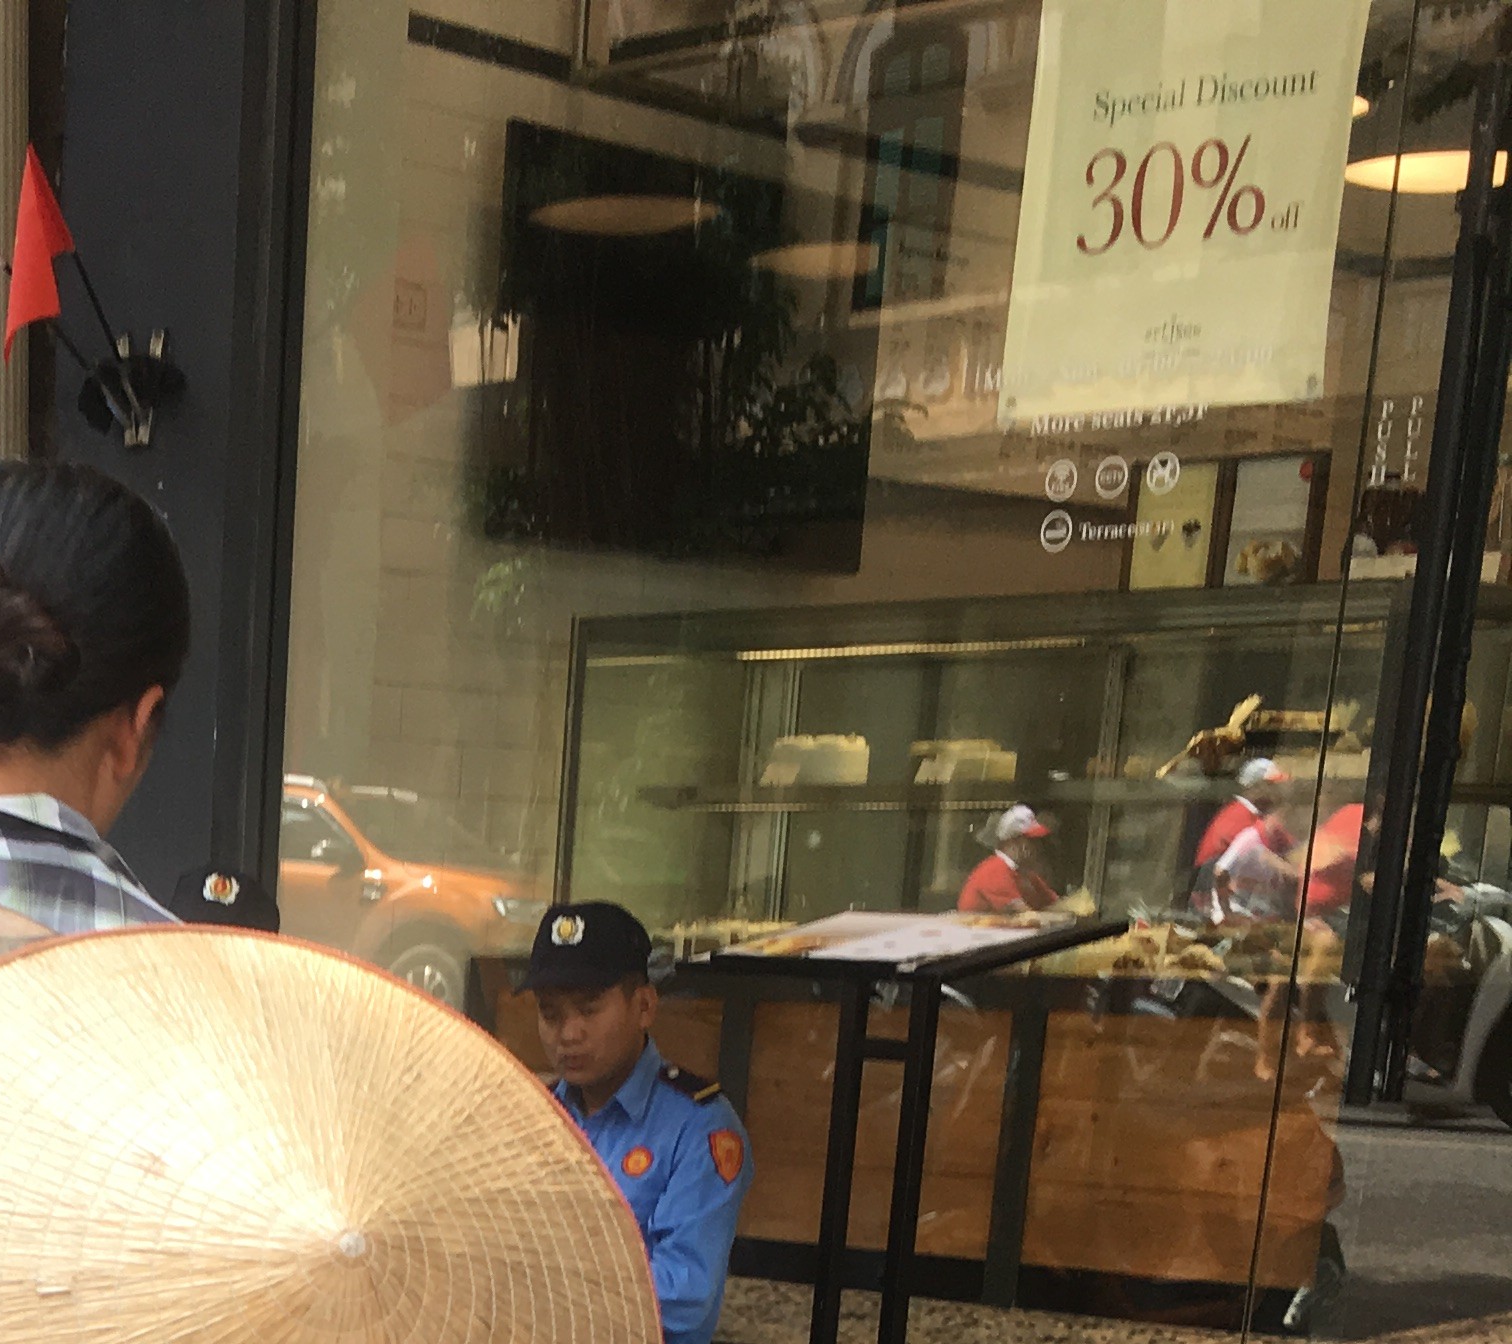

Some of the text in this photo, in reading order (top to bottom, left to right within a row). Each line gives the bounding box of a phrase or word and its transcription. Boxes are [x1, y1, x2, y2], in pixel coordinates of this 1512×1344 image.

[1092, 70, 1318, 128] Special Discount
[1075, 133, 1266, 255] 30%
[1368, 400, 1395, 488] PUSH
[1402, 395, 1424, 482] PULL
